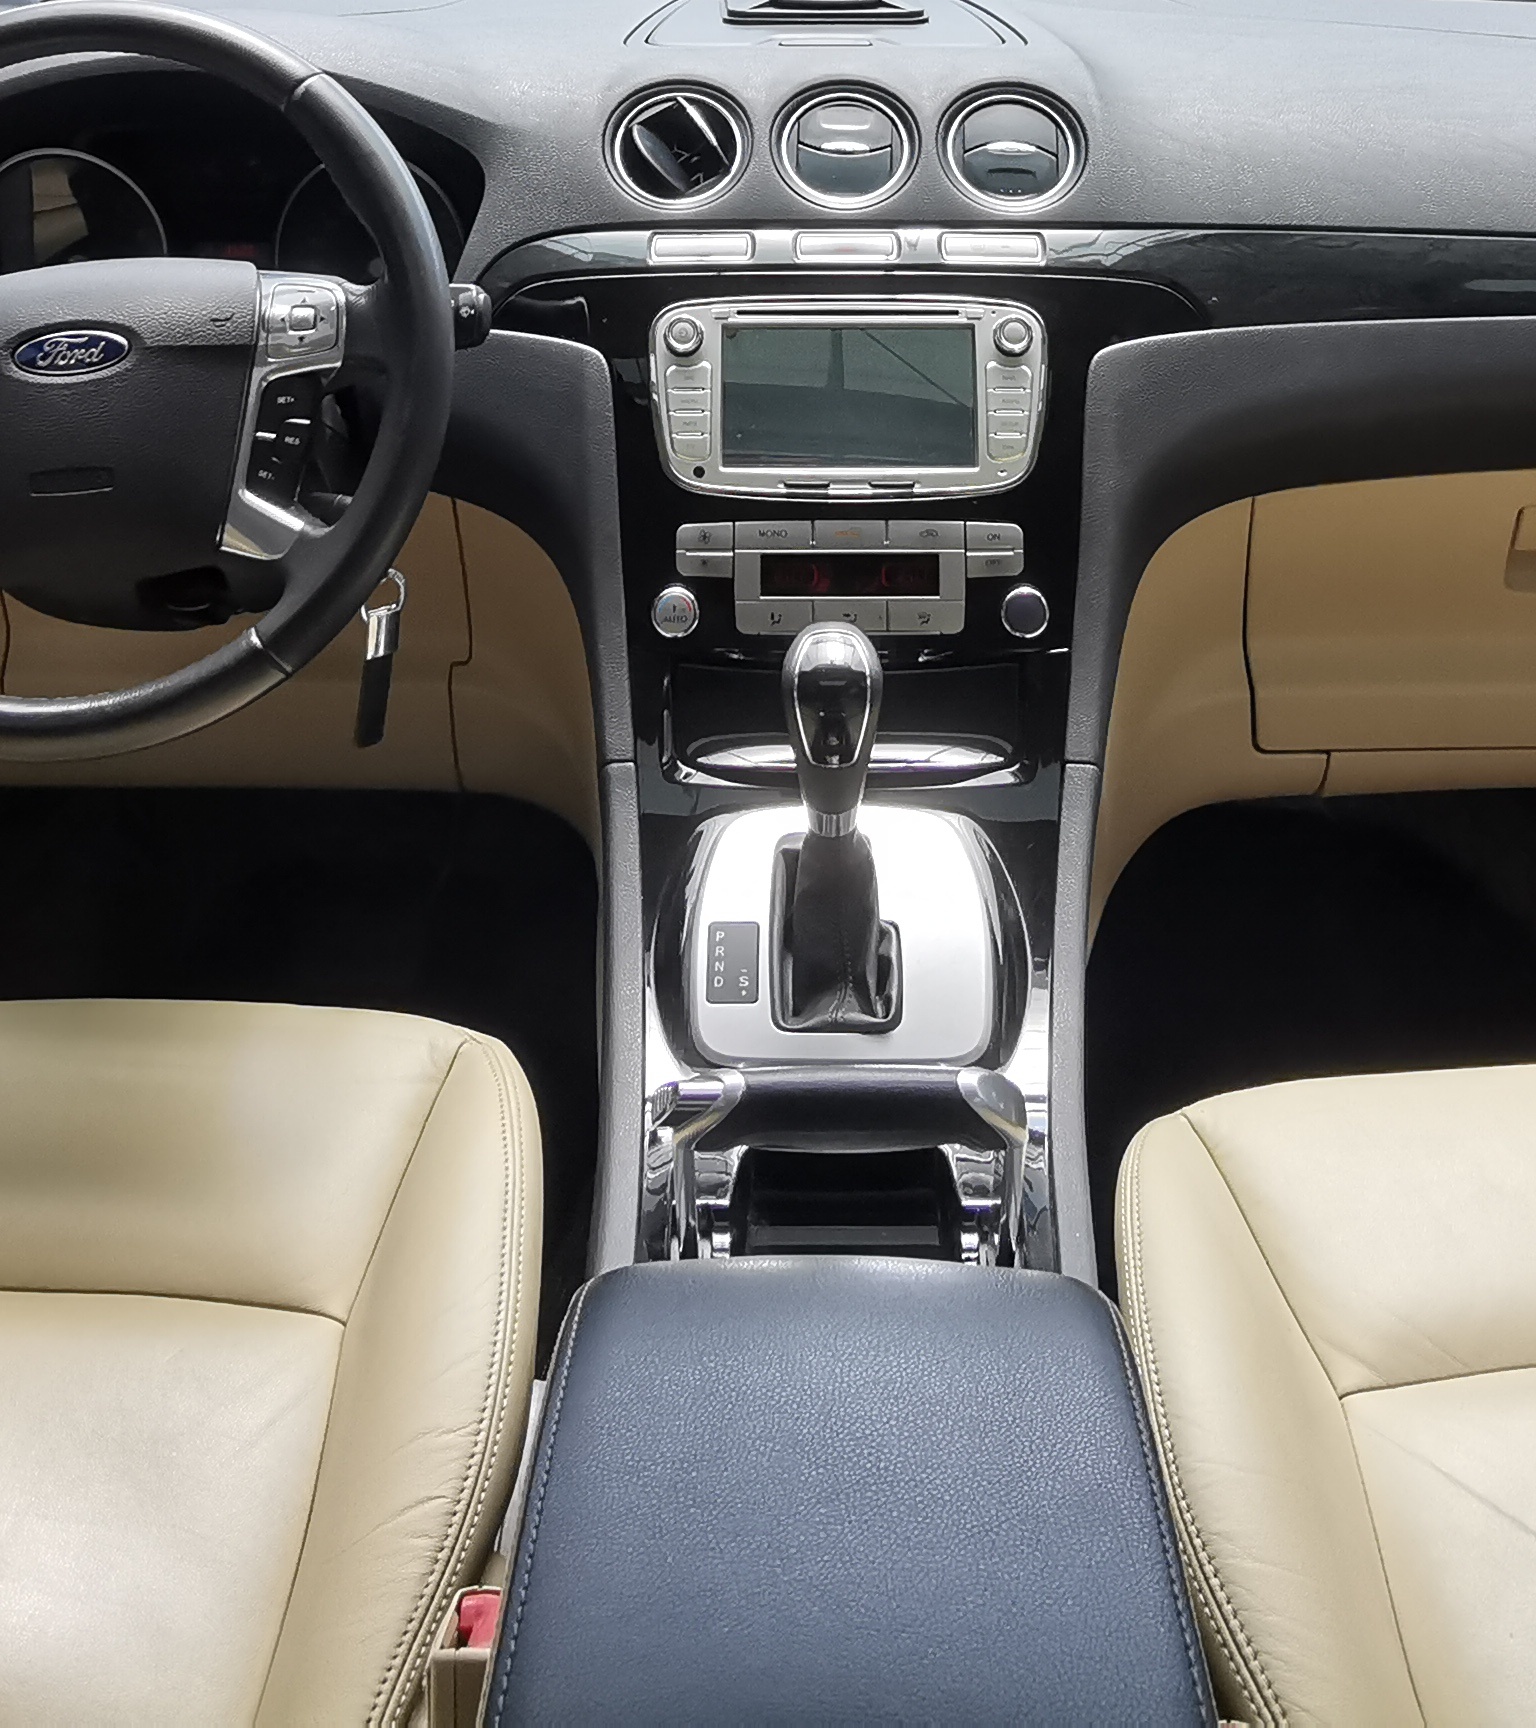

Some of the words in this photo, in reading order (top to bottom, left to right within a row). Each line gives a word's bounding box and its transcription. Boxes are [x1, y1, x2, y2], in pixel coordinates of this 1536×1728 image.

[35, 336, 106, 367] Ford
[758, 528, 789, 540] MONO
[986, 531, 1002, 542] ON
[715, 930, 725, 942] P
[714, 945, 725, 957] R
[714, 960, 725, 972] N
[713, 975, 724, 988] D
[738, 975, 750, 987] S
